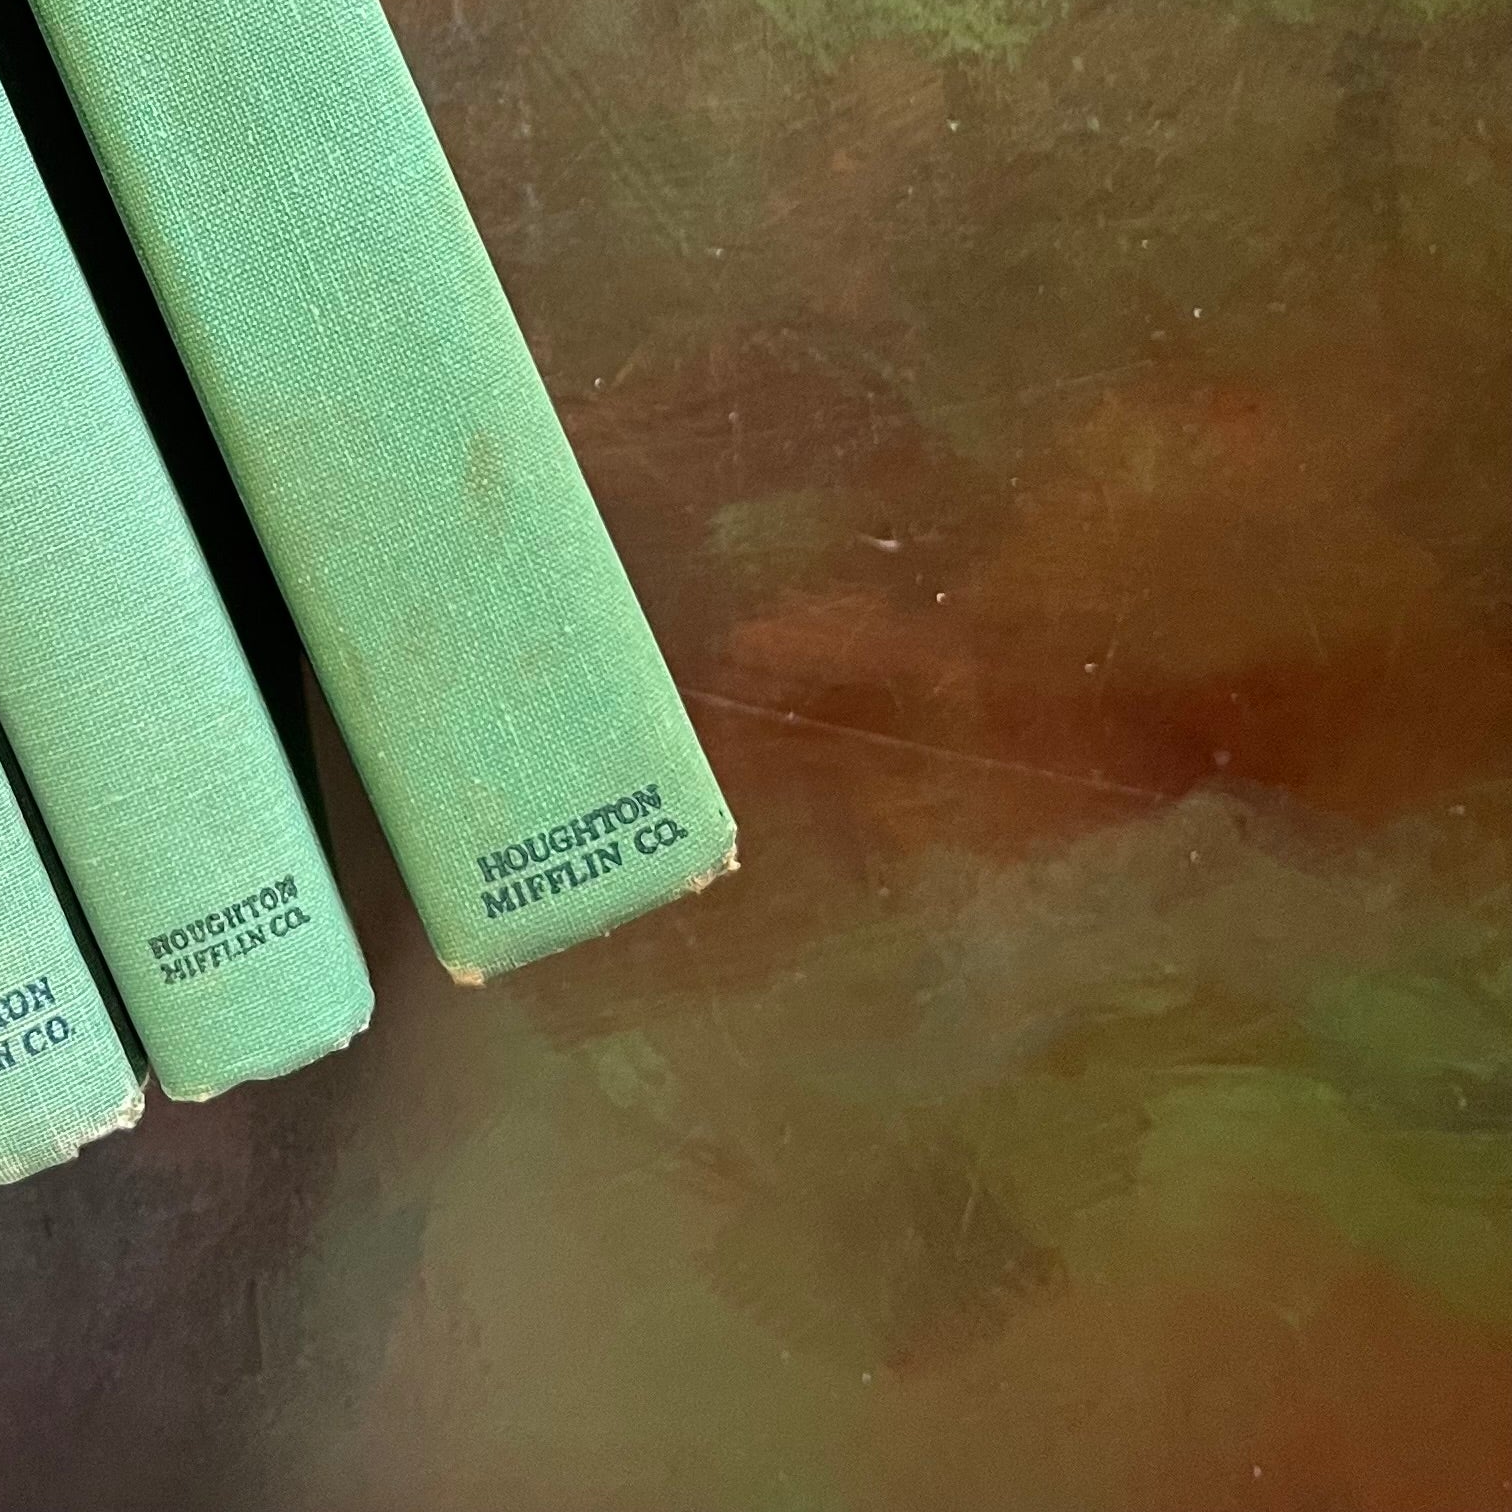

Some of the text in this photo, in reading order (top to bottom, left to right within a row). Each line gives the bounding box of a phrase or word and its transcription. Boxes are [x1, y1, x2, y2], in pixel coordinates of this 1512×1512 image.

[477, 784, 662, 884] HOUGHTON
[480, 815, 689, 919] MIFFLIN CO.
[148, 874, 299, 960] HOUGHTON
[160, 905, 310, 985] MIFFLIN CO.
[24, 1014, 76, 1059] CO.
